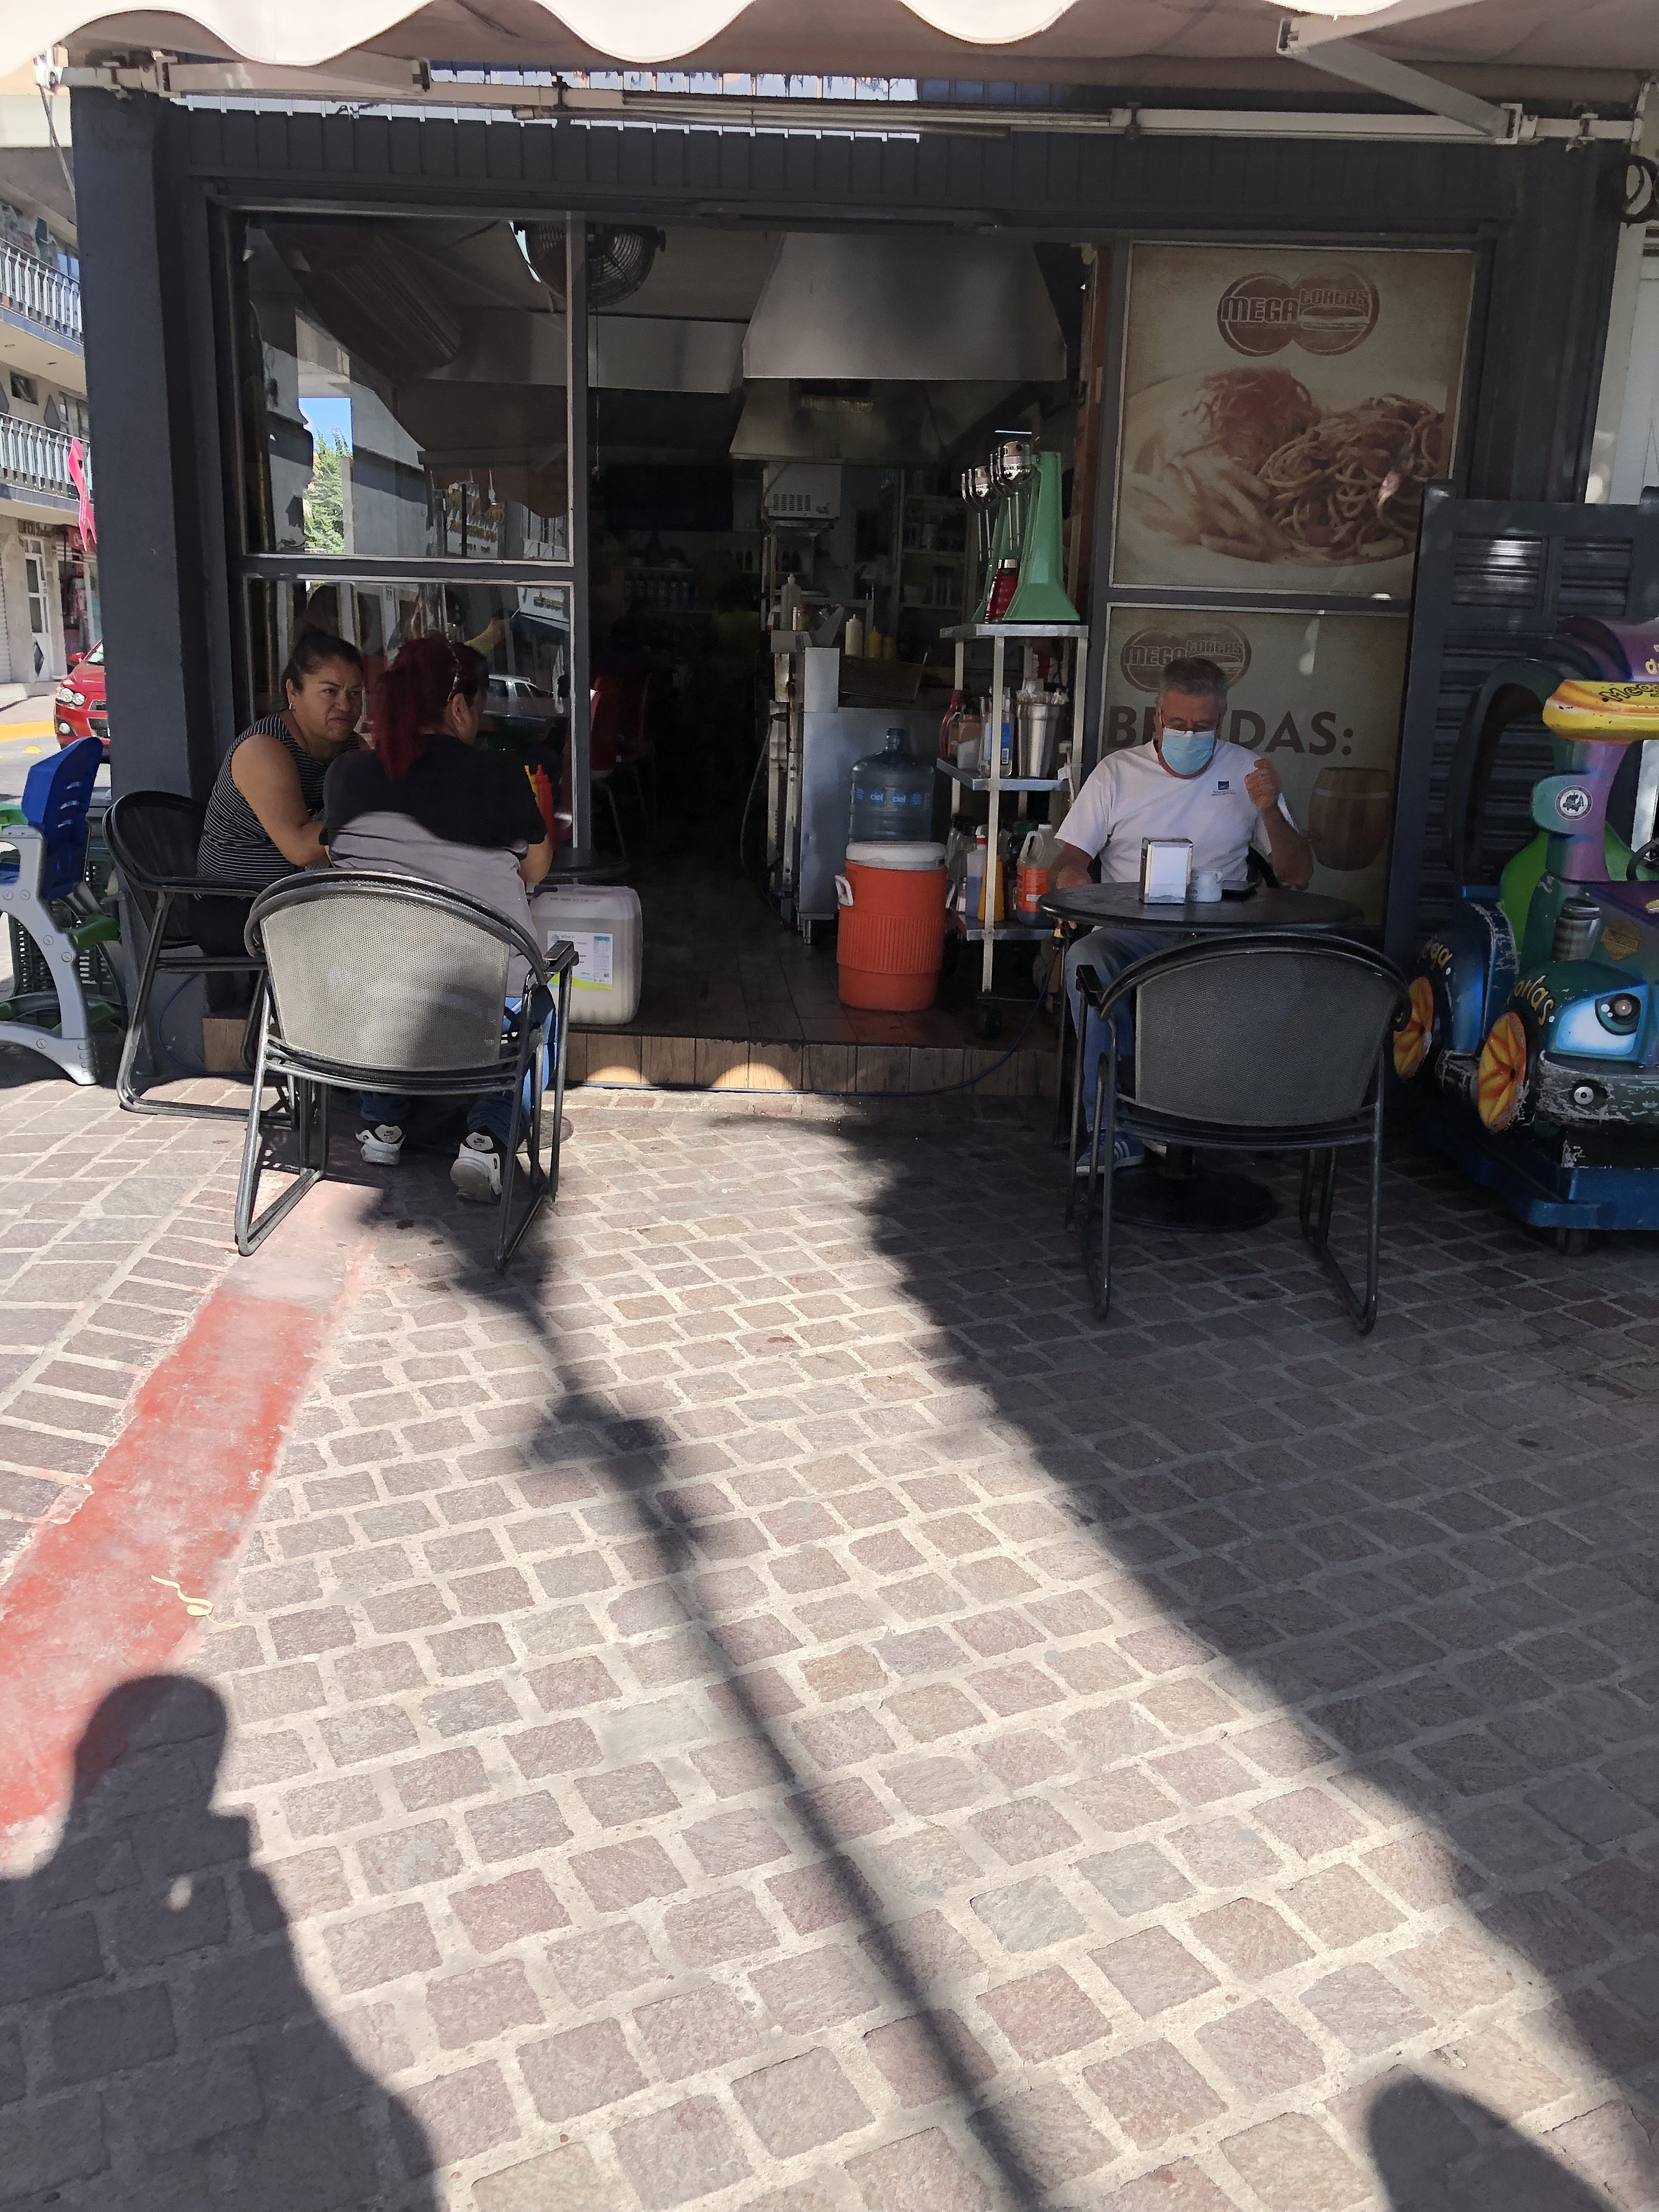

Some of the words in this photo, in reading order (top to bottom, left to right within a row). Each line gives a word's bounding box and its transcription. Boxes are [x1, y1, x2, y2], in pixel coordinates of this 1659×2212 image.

[1221, 296, 1299, 324] MEGA
[1107, 705, 1354, 756] BDAS:
[870, 792, 884, 802] ciel
[892, 794, 906, 803] ciel
[1417, 938, 1453, 970] ega
